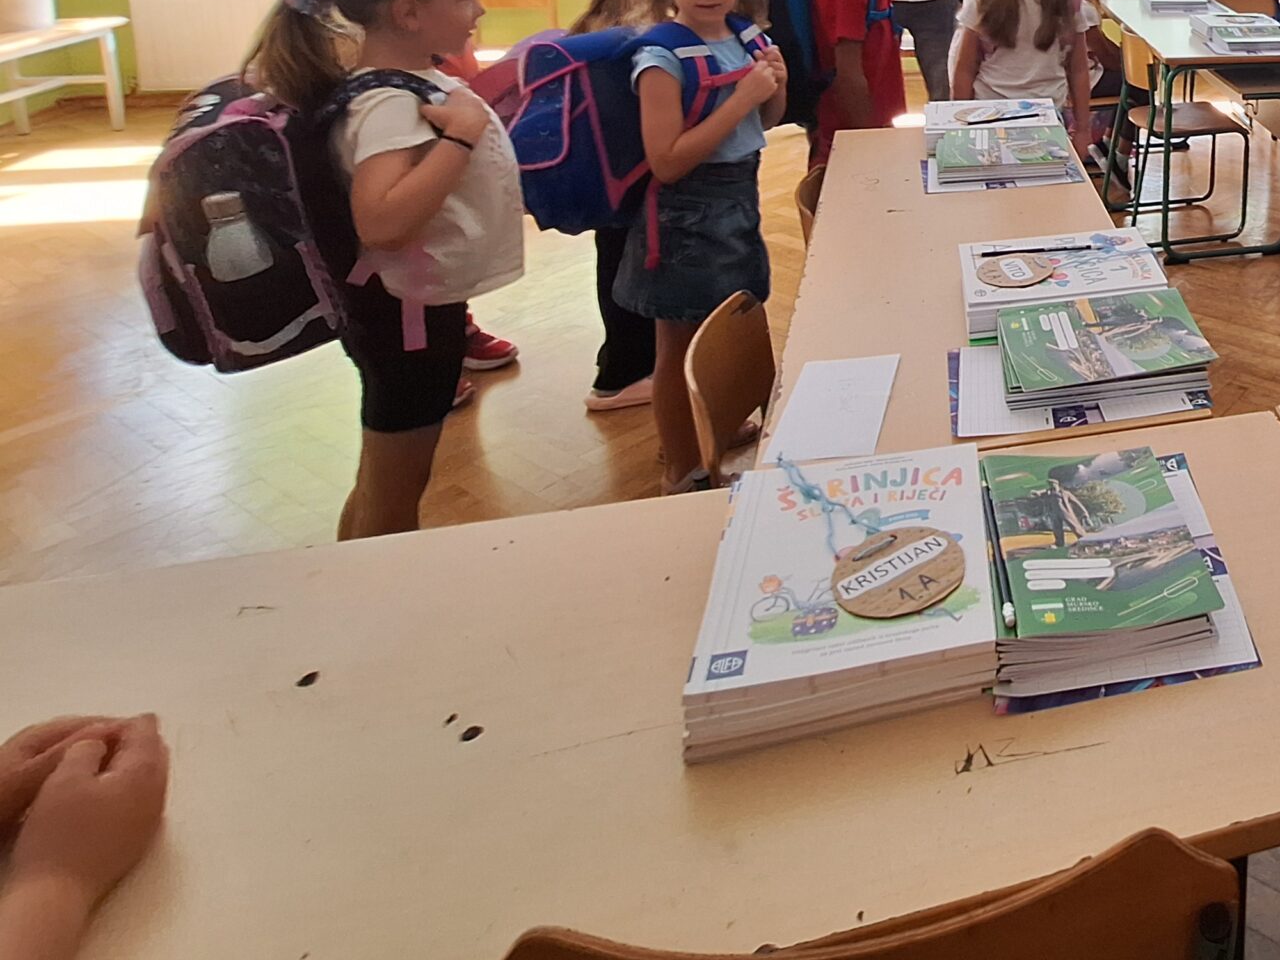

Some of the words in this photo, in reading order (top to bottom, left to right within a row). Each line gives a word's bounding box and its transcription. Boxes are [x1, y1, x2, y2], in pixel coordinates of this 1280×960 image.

[1003, 260, 1027, 278] VITO
[777, 467, 963, 511] ŠRINJICA
[797, 497, 864, 521] SLA
[887, 485, 947, 503] RIJEČI
[841, 537, 943, 595] KRISTIJAN
